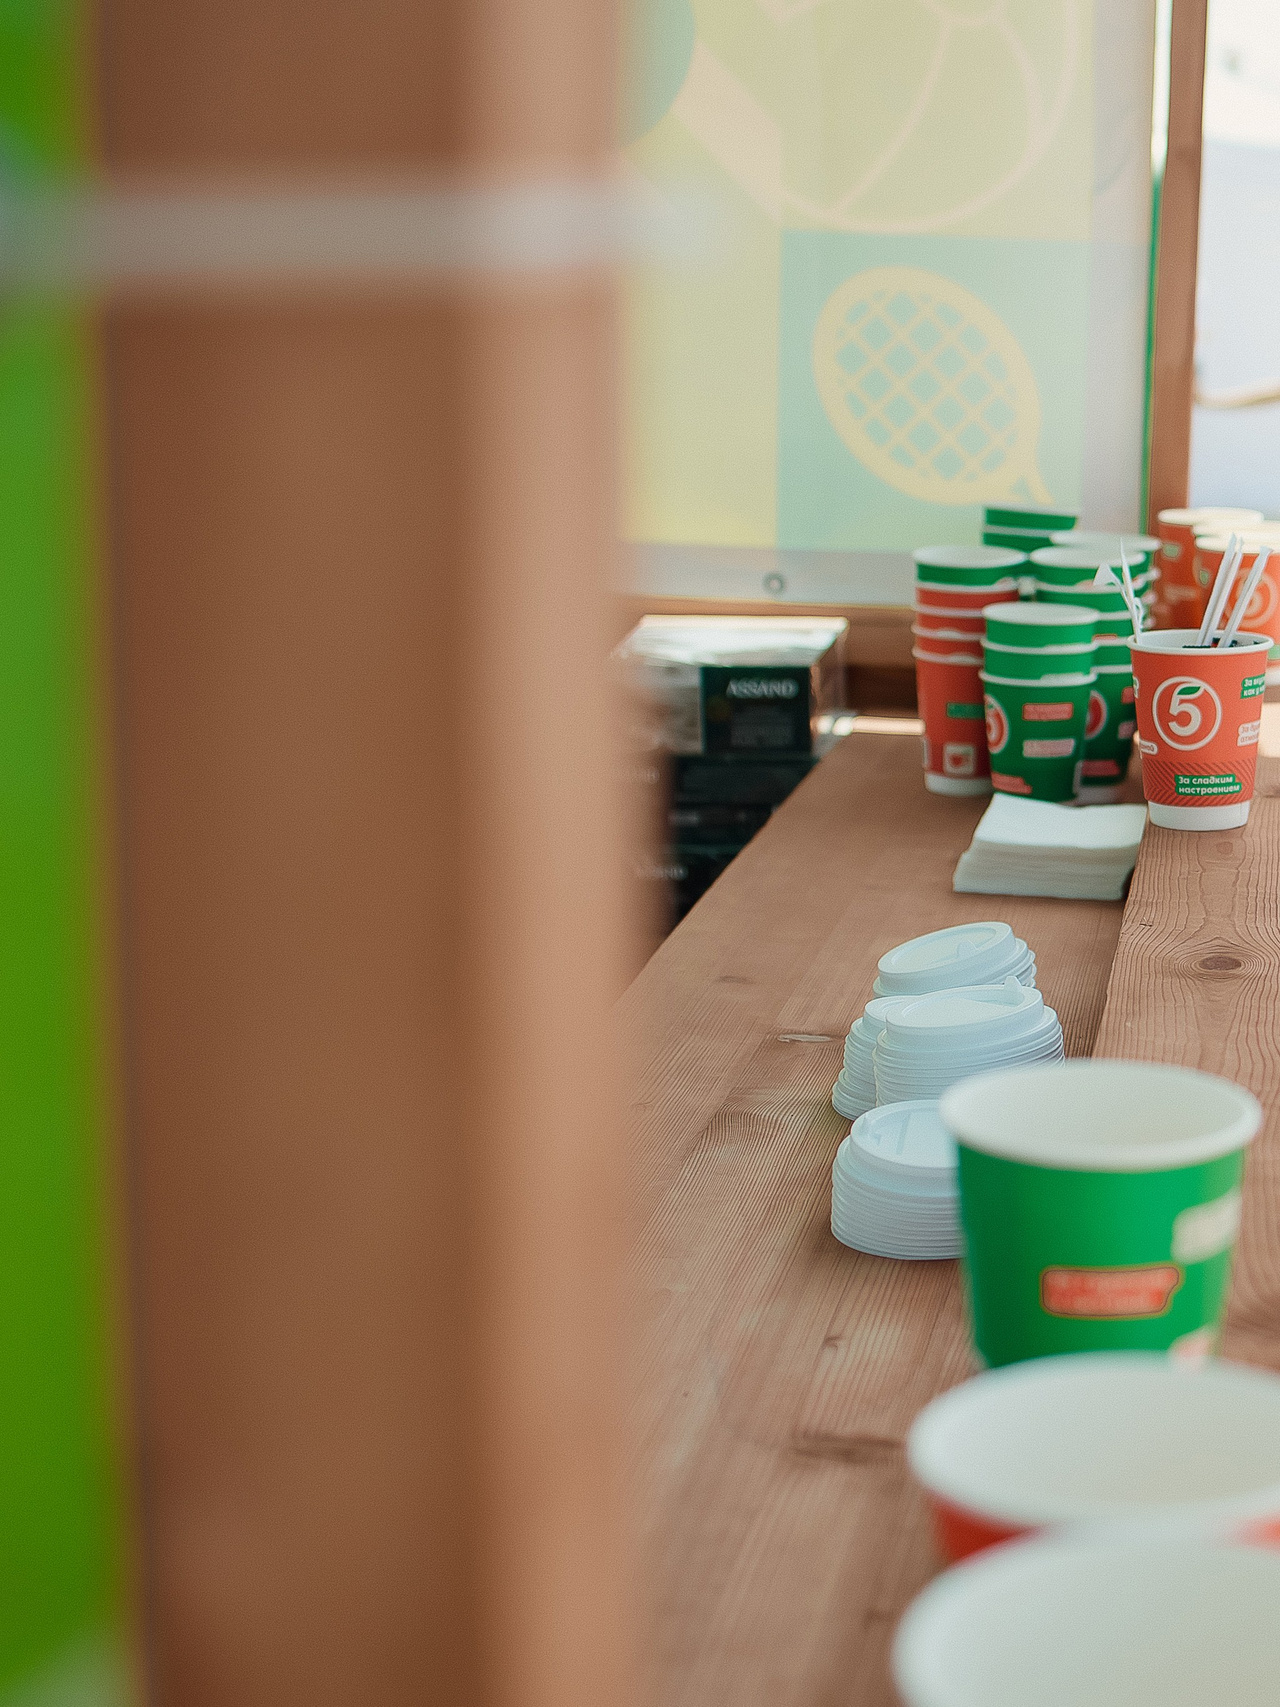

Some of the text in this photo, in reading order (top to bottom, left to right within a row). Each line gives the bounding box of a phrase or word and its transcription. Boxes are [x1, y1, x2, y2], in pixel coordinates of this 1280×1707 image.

[1178, 776, 1233, 785] За сладким
[1178, 785, 1240, 796] настроением
